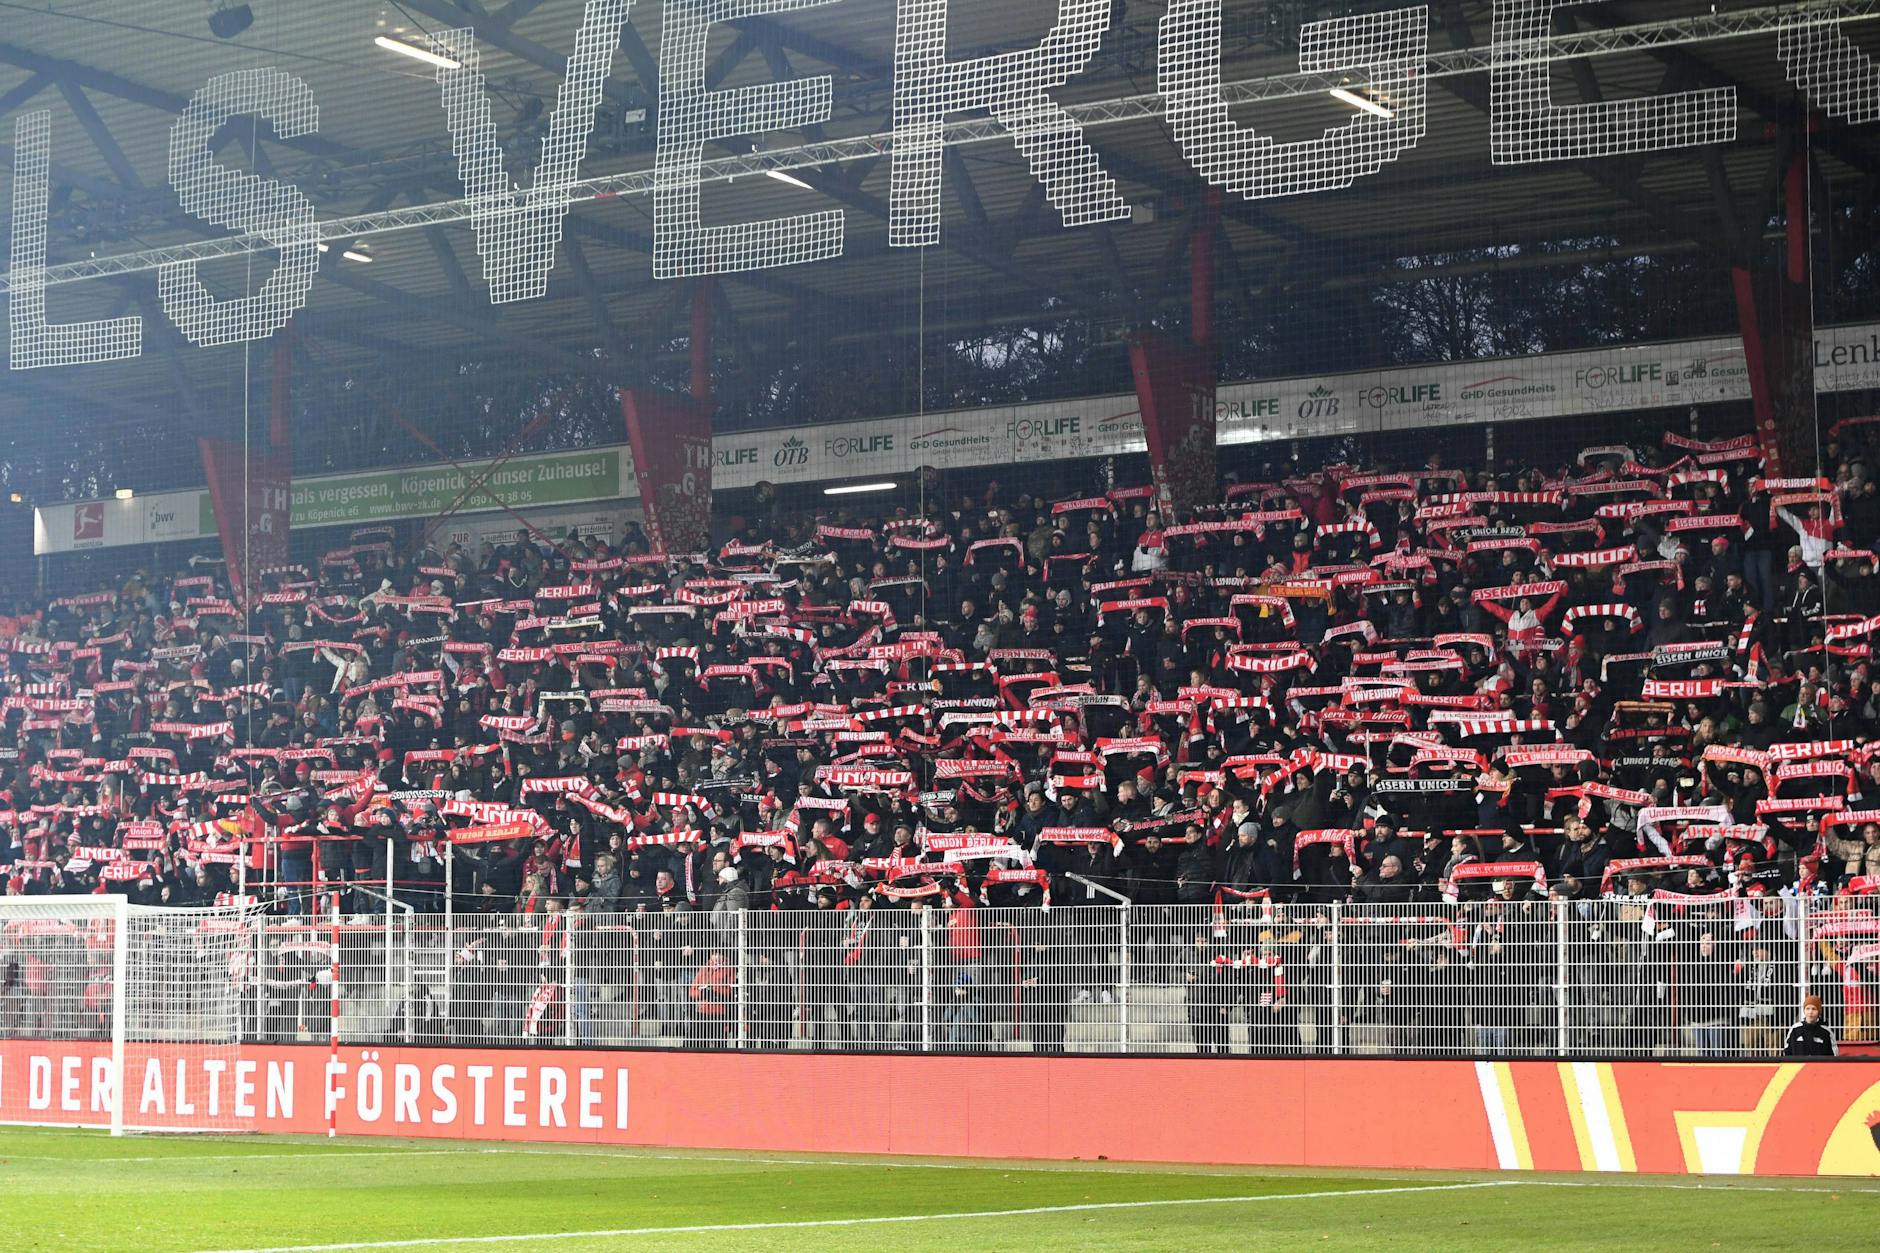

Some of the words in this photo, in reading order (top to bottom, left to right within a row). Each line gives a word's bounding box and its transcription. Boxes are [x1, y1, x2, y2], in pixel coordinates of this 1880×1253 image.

[1576, 362, 1662, 389] FORLIFE
[1358, 384, 1441, 409] FORLIFE
[1460, 390, 1483, 401] GHD
[1487, 384, 1556, 398] GesundHeits
[1298, 397, 1340, 420] OTB
[1006, 417, 1080, 440] FORLIFE
[825, 434, 893, 459] FORLIFE
[910, 440, 930, 450] GHD
[932, 435, 991, 448] GesundHeits
[774, 447, 809, 467] OTB
[318, 482, 394, 503] vergessen,
[400, 472, 466, 498] Köpenick
[493, 468, 534, 485] unser
[537, 457, 607, 479] Zuhause!
[1380, 473, 1410, 483] UNION
[155, 510, 175, 524] bwv
[308, 504, 346, 520] Köpenick
[1708, 514, 1737, 526] UNION
[1472, 526, 1498, 535] UNION
[1504, 538, 1532, 547] UNION
[1554, 547, 1632, 565] UNION
[1337, 572, 1371, 582] UNIONER
[1473, 586, 1520, 600] EISERN
[1522, 580, 1565, 595] UNION
[1234, 651, 1308, 672] UNION
[1656, 652, 1692, 665] EISERN
[1694, 648, 1729, 661] UNION
[715, 665, 738, 674] UNION
[1154, 701, 1178, 710] Union
[485, 715, 531, 730] UNION
[1372, 710, 1407, 721] Union
[618, 734, 669, 750] UNION
[1057, 751, 1092, 762] UNIONER
[1517, 753, 1529, 762] FC
[1530, 752, 1558, 761] UNION
[1558, 751, 1588, 761] BERLIN
[1622, 756, 1650, 766] Union
[1815, 759, 1847, 774] UNION
[522, 776, 589, 793] UNION
[1376, 780, 1415, 792] EISERN
[1419, 780, 1459, 790] UNION
[1771, 800, 1793, 809] UNION
[1650, 806, 1677, 818] Union
[1680, 806, 1711, 817] Berlin
[130, 827, 152, 835] Union
[930, 839, 963, 849] UNION
[966, 837, 1005, 848] BERLIN
[1620, 858, 1642, 868] WIR
[1644, 855, 1682, 866] FOLGEN
[998, 870, 1037, 880] UNIONER
[140, 1055, 294, 1120] ALTEN
[324, 1050, 629, 1130] FÖRSTEREI
